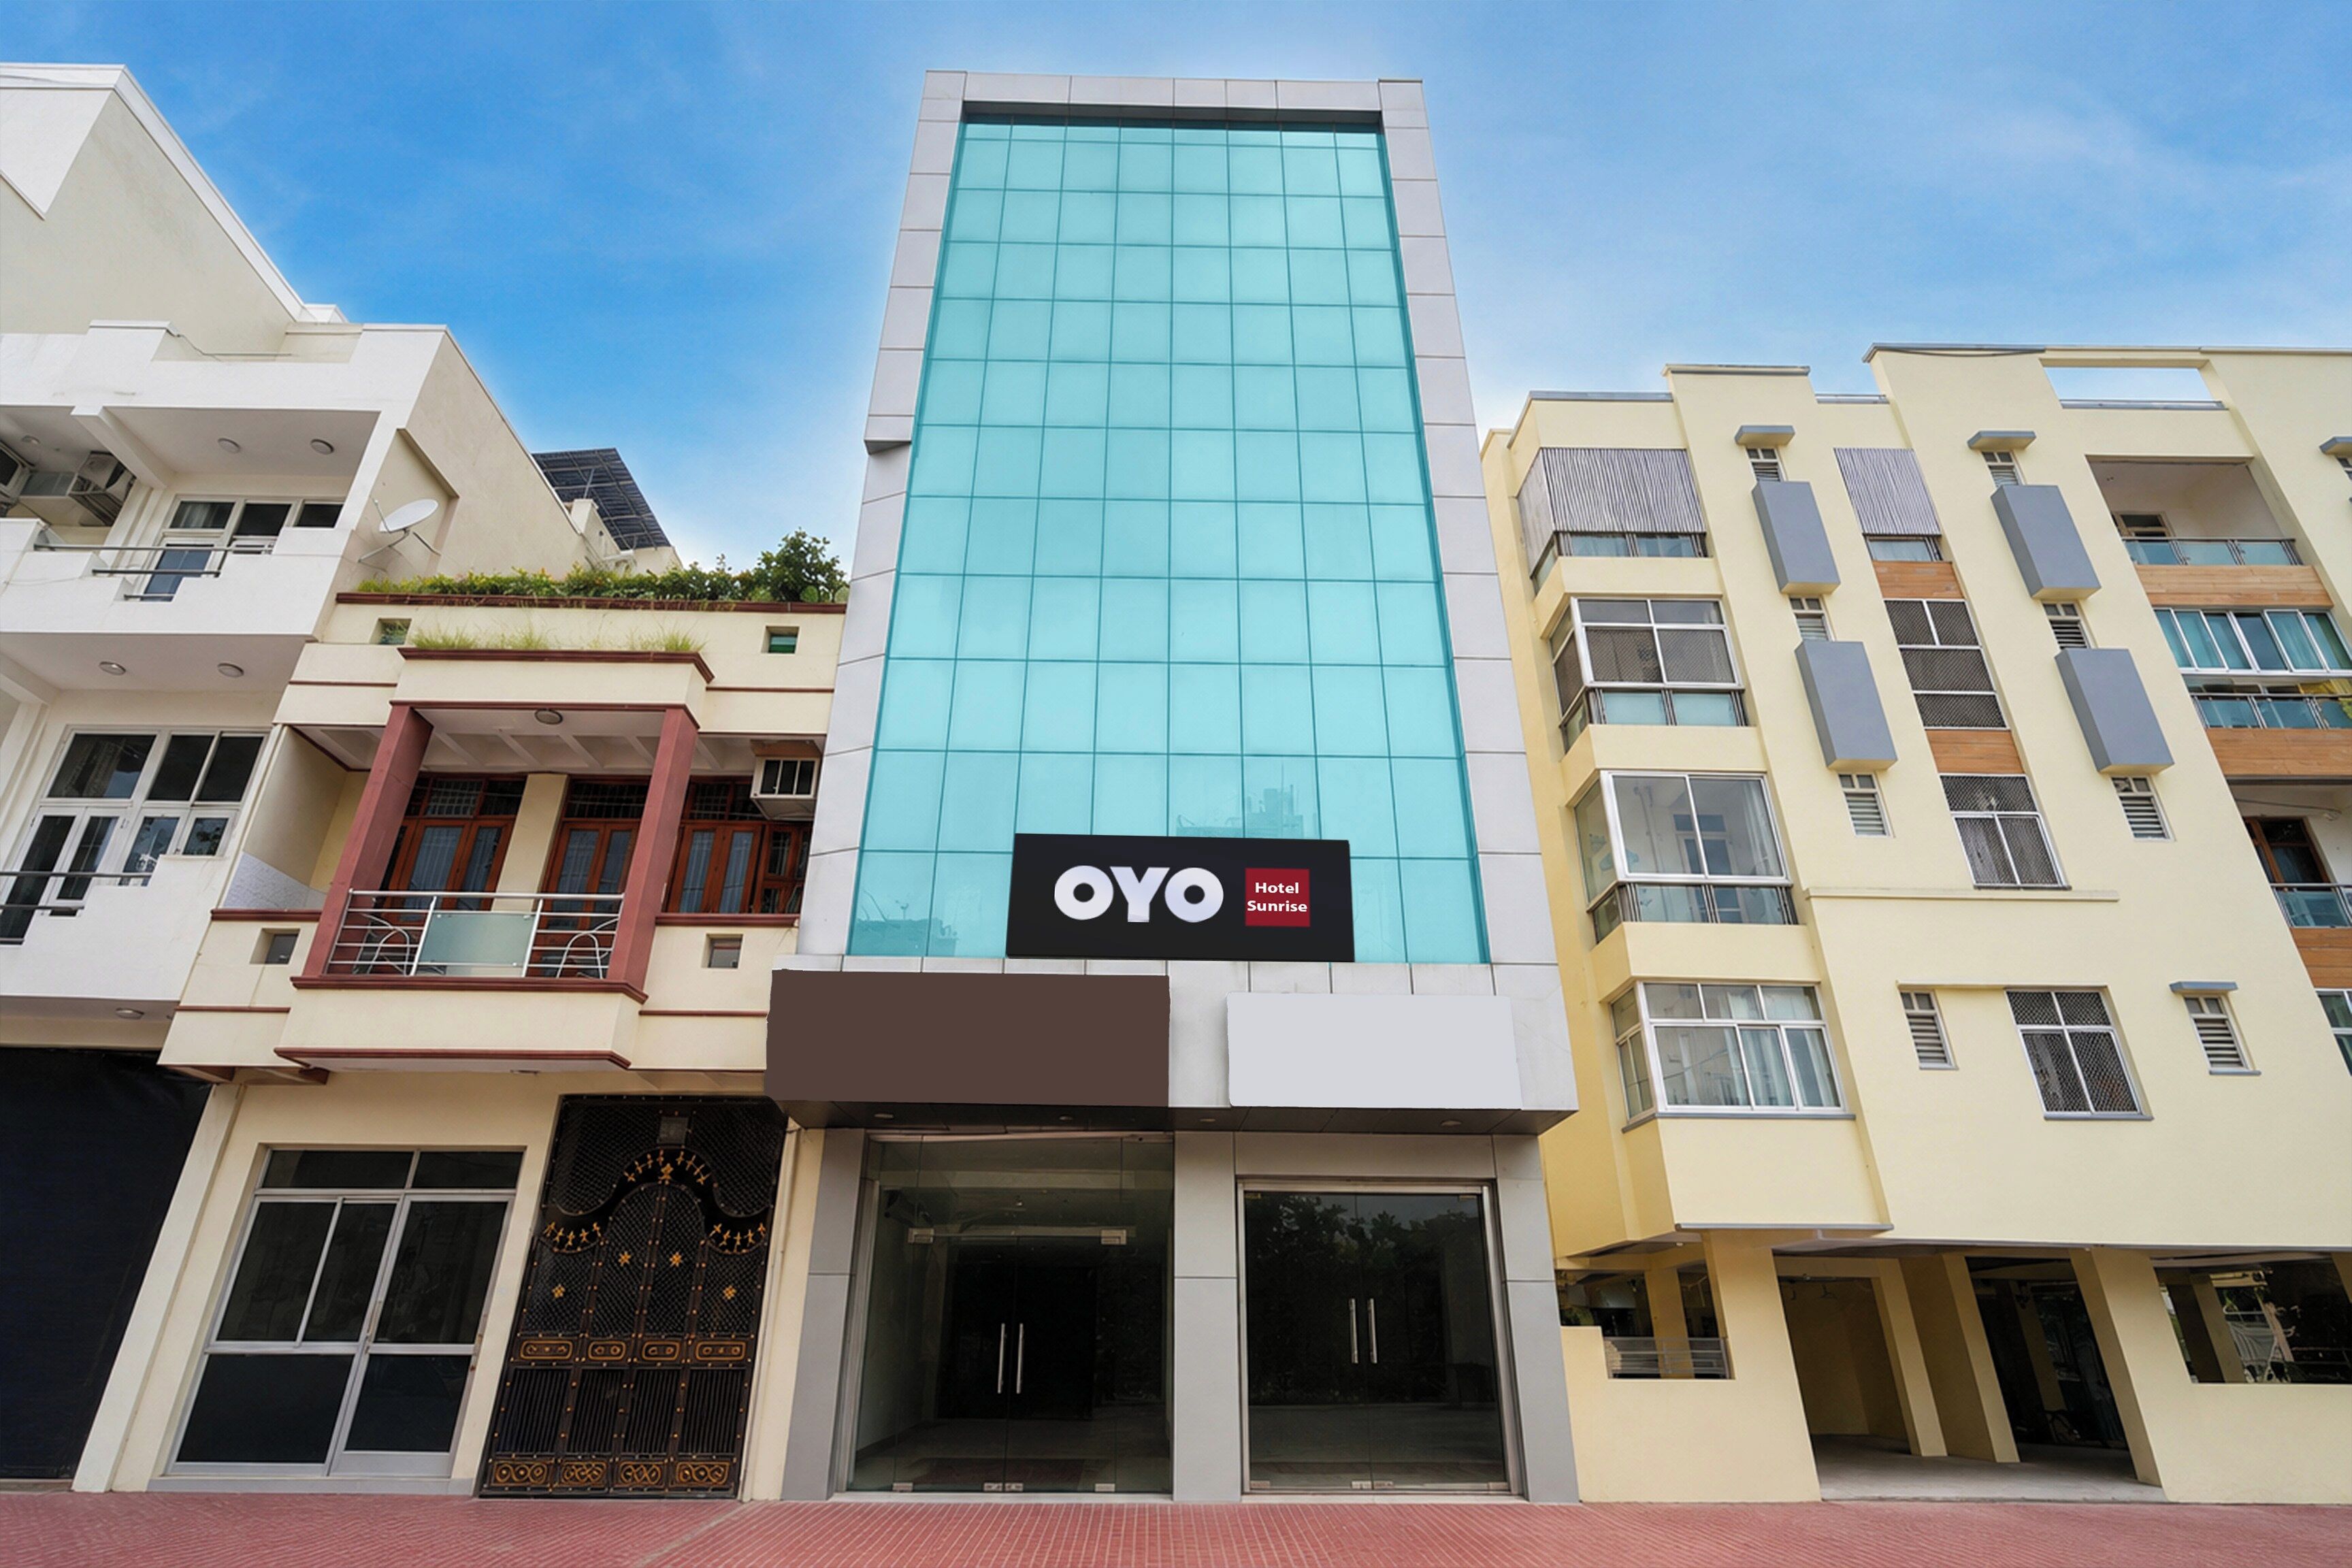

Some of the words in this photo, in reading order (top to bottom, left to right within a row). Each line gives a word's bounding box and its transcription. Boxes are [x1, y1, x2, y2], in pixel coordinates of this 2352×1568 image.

[1054, 865, 1224, 922] OYO
[1255, 881, 1299, 894] Hotel
[1247, 900, 1308, 913] Sunrise
